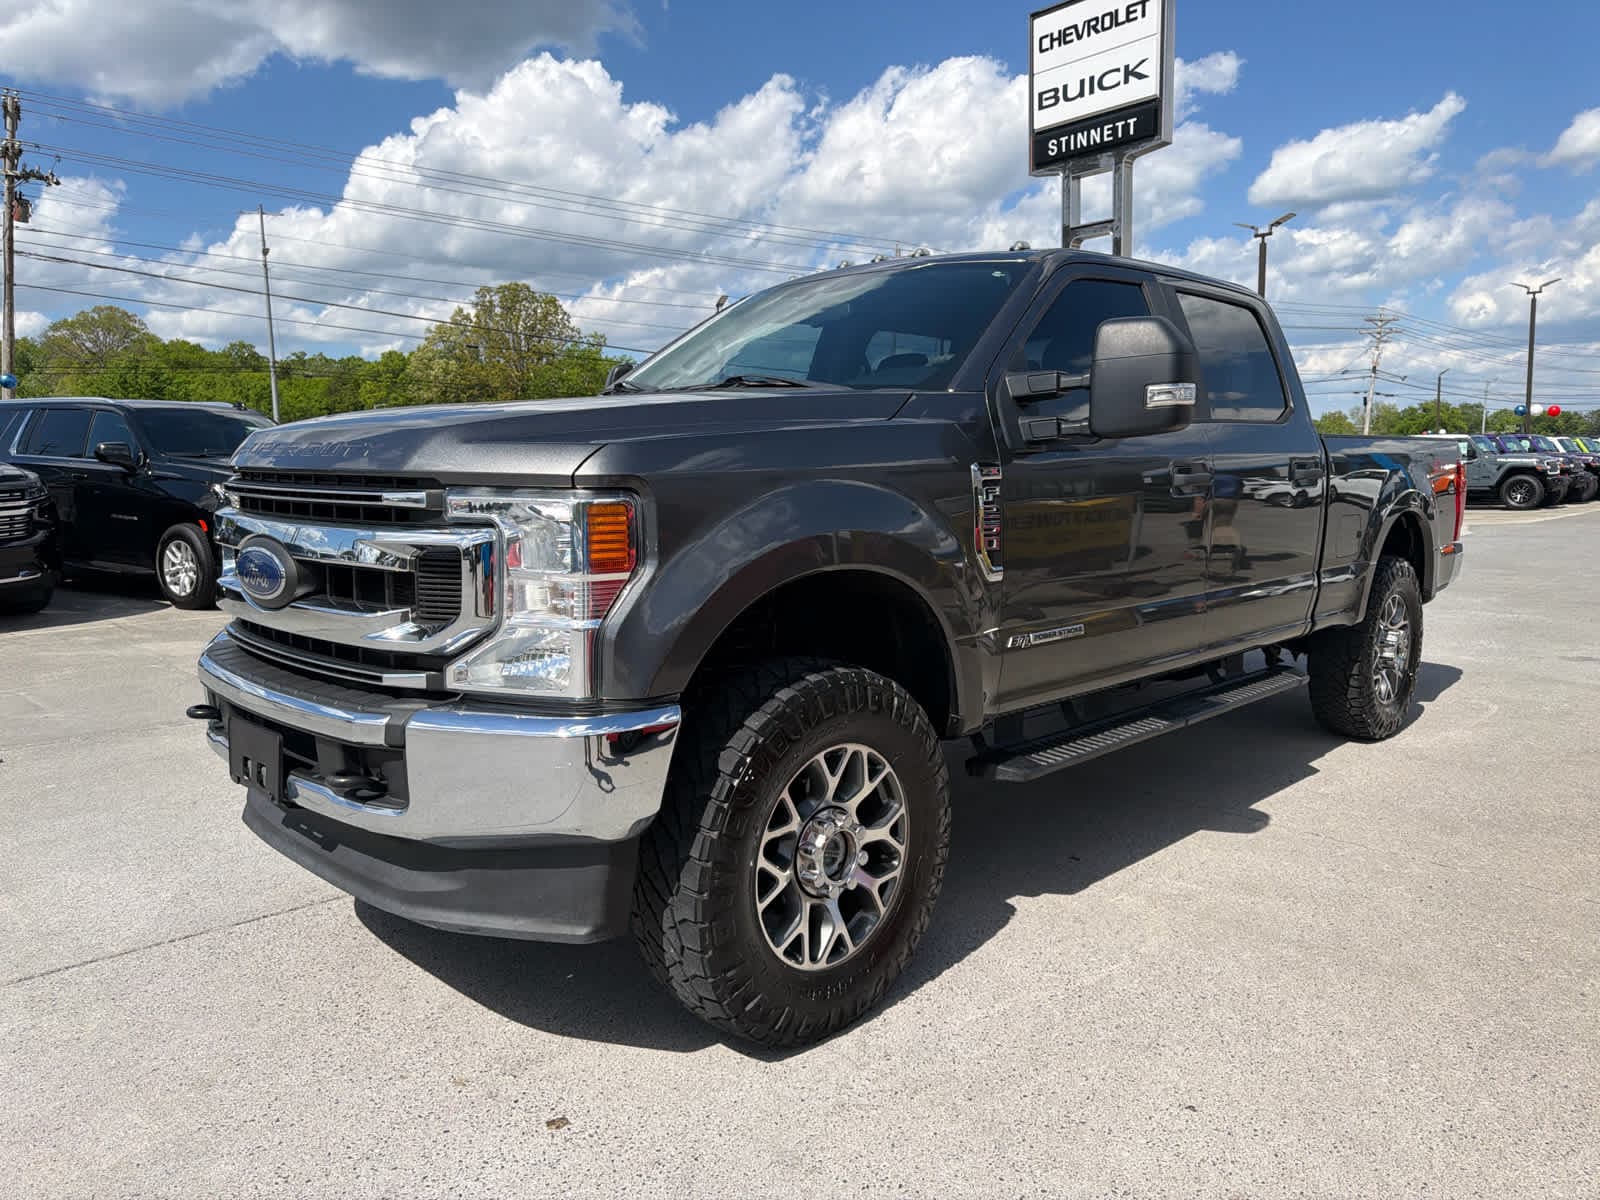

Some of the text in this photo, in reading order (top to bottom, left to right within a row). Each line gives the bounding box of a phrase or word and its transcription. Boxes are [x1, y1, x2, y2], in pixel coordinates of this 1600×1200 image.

[1038, 0, 1150, 54] CHEVROLET
[1037, 57, 1150, 111] BUICK
[1047, 117, 1138, 156] STINNETT
